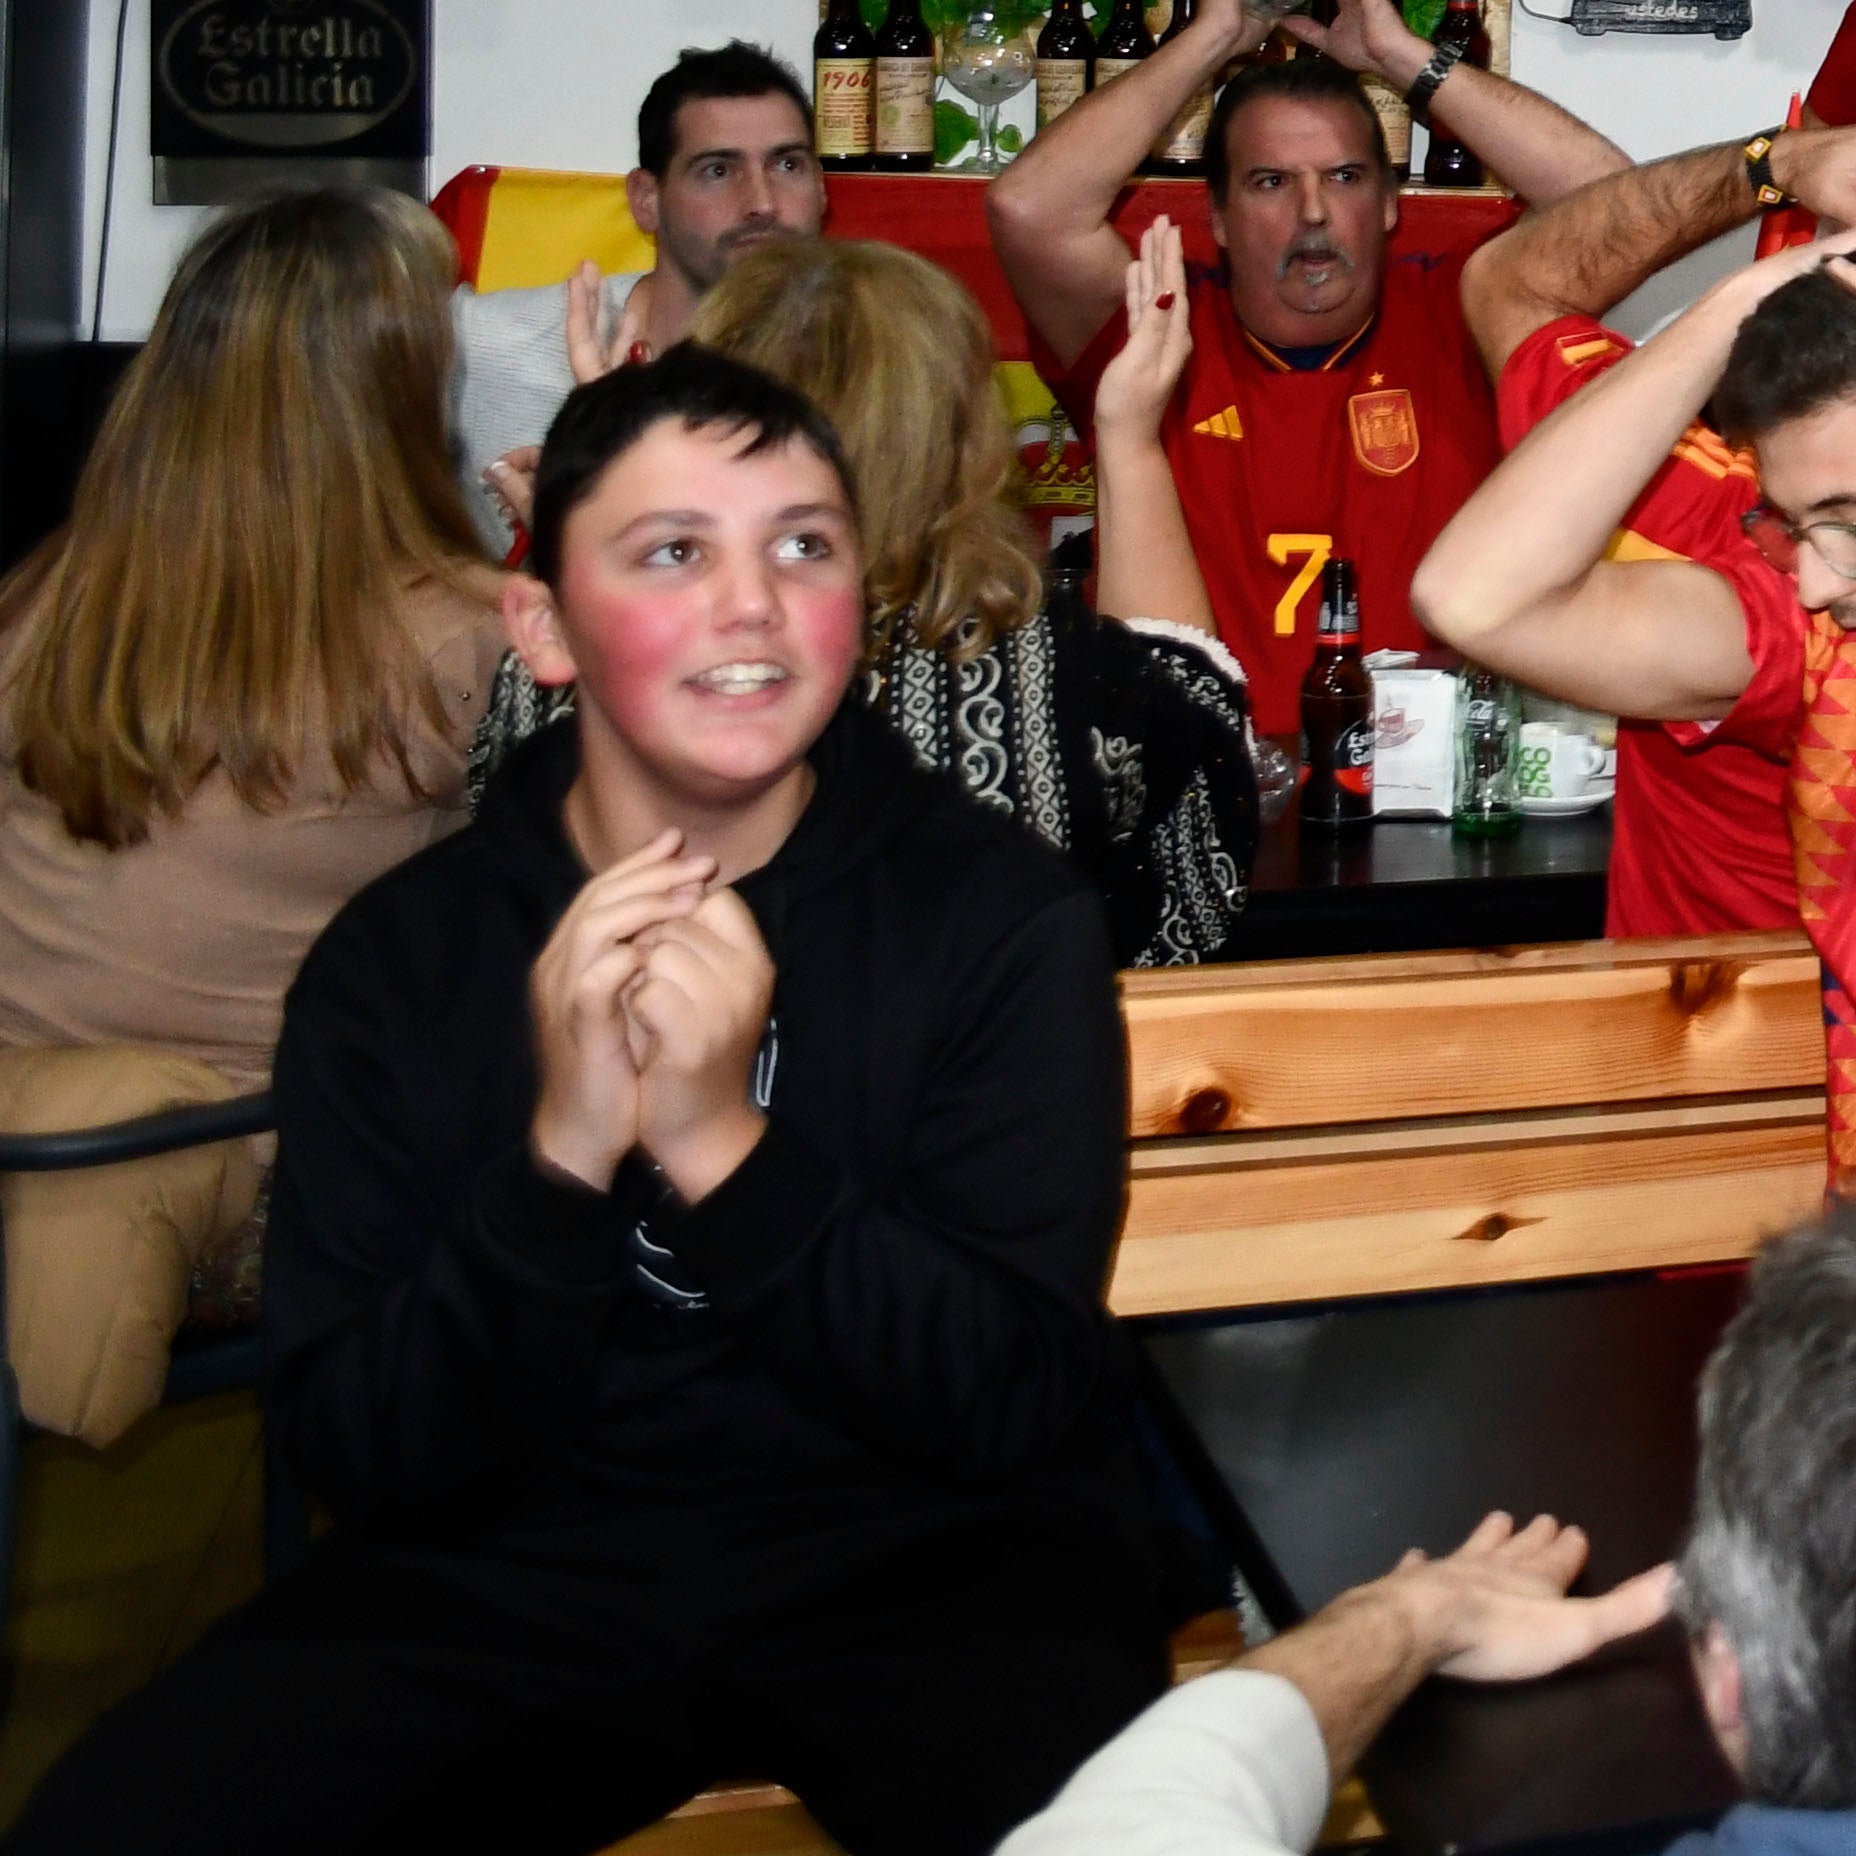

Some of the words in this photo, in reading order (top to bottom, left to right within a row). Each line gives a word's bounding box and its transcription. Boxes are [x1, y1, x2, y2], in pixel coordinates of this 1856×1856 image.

[1624, 1, 1700, 21] ustedes
[198, 13, 384, 58] Estrella
[205, 65, 376, 108] Galicia
[820, 69, 871, 89] 1906
[1266, 532, 1334, 637] 7
